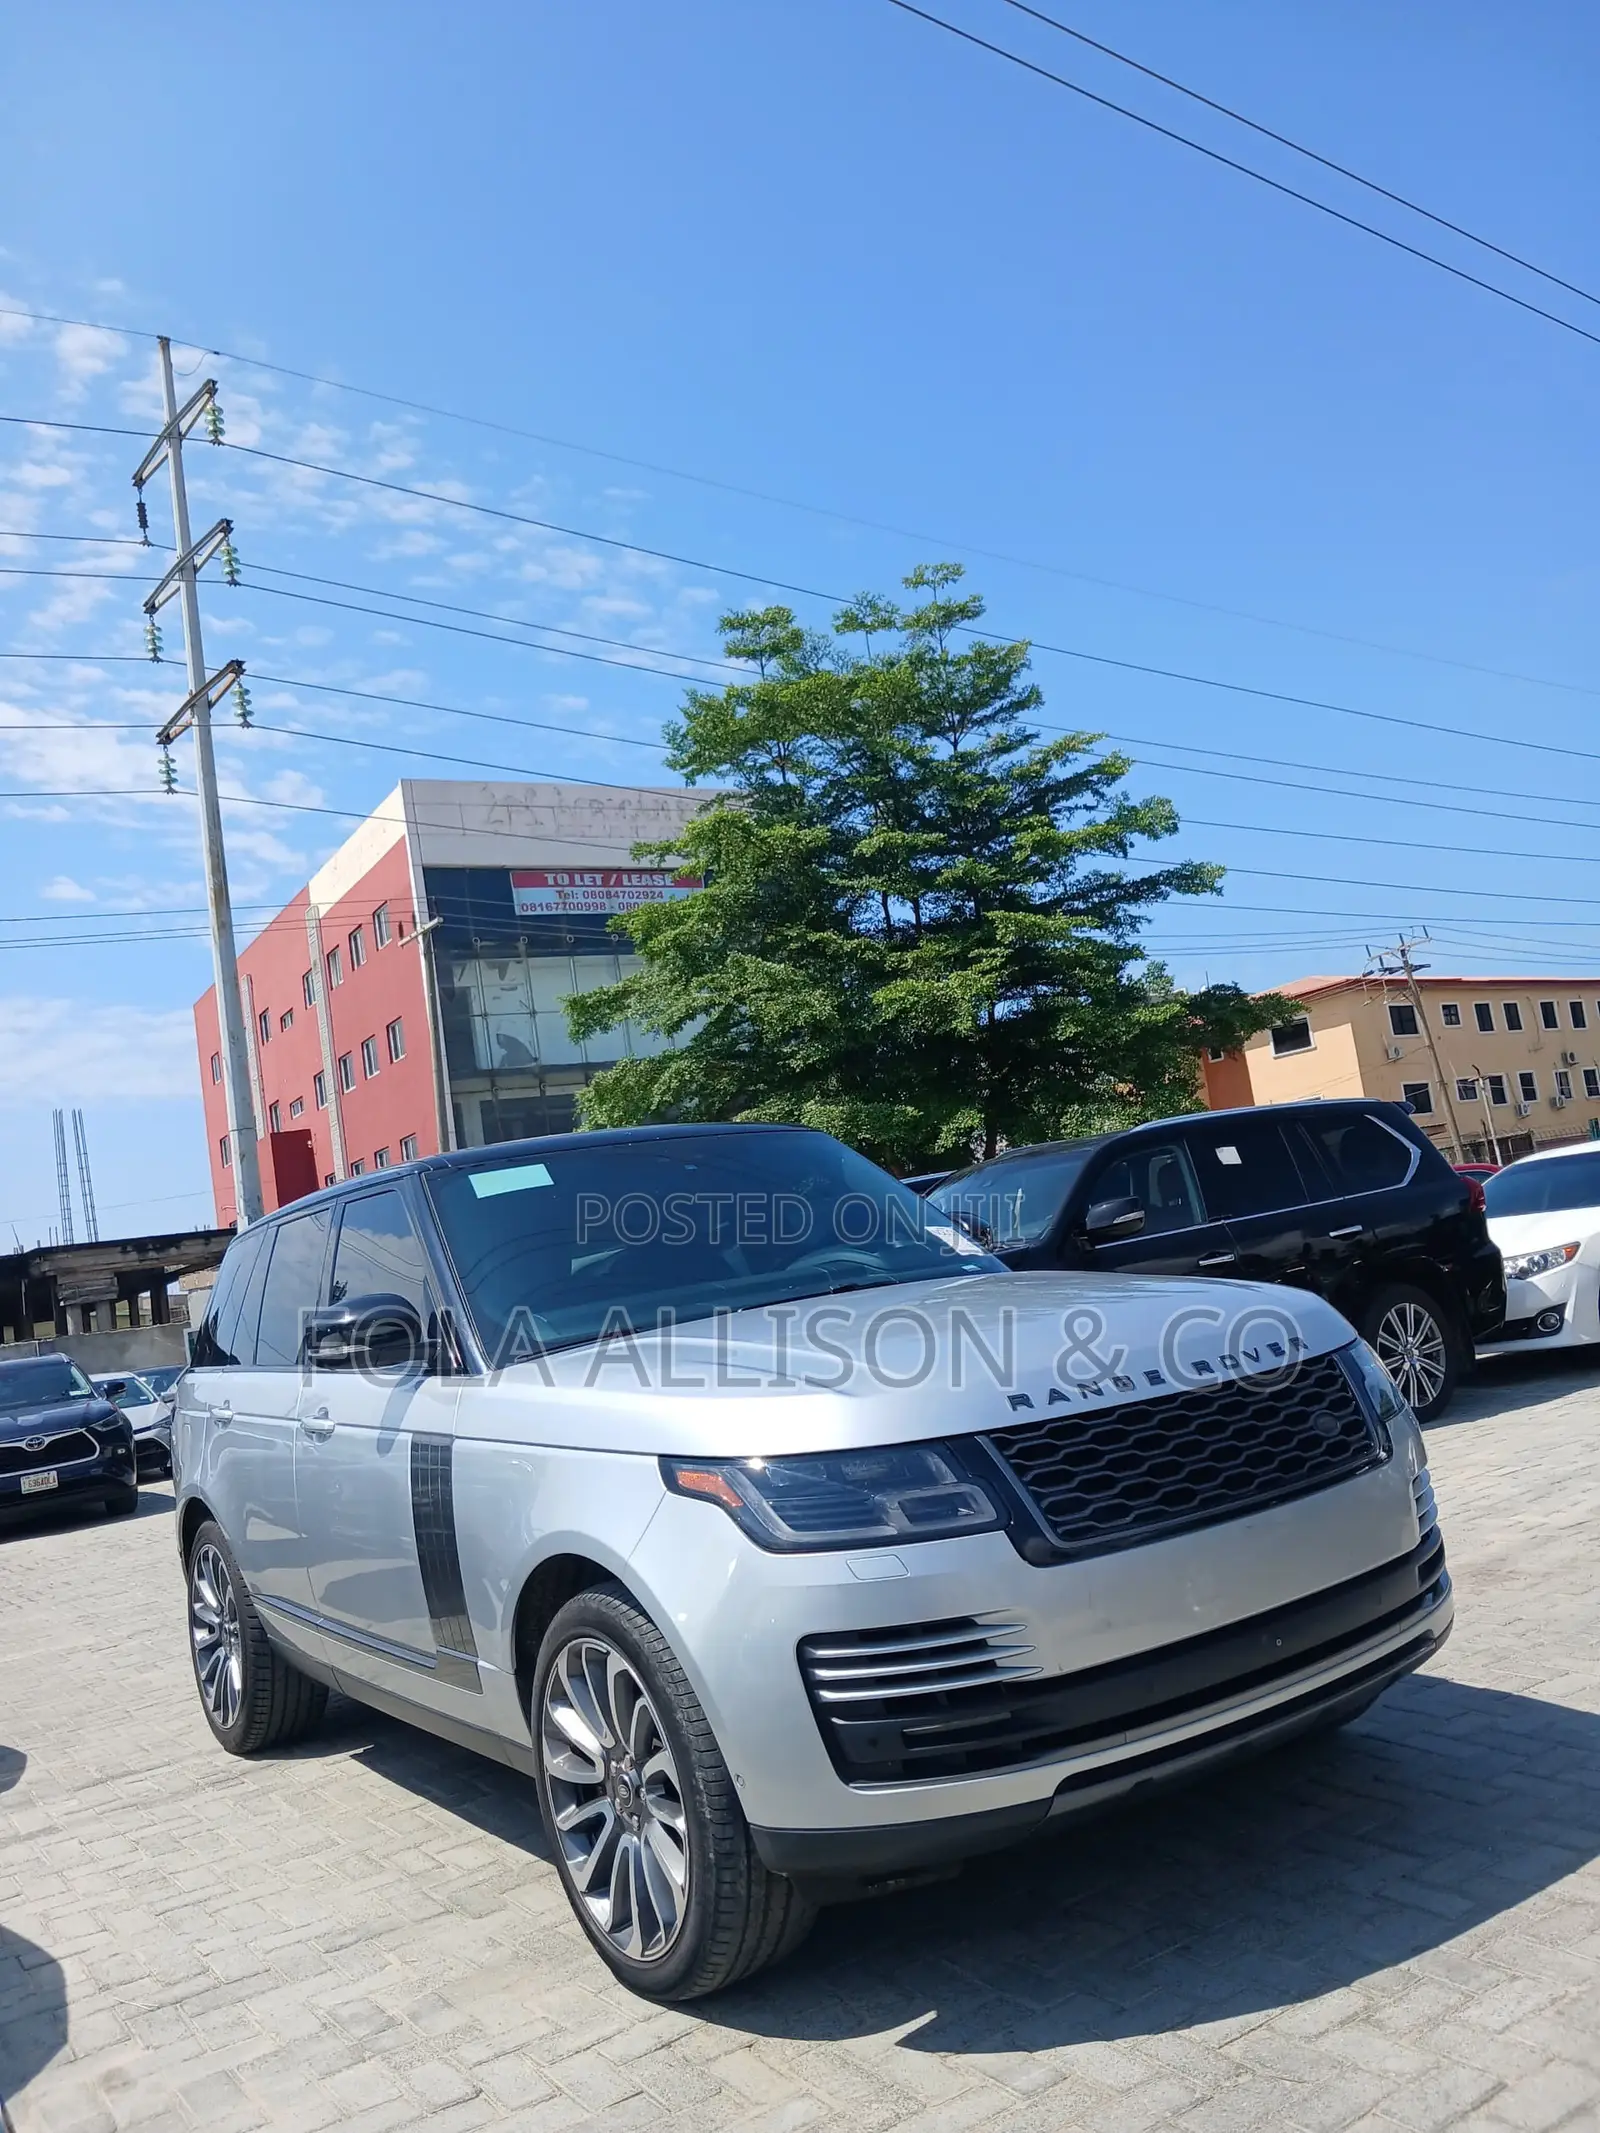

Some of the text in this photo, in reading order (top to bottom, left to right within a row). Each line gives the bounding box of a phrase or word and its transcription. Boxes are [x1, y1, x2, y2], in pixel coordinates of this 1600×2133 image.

[544, 873, 570, 886] TO
[574, 873, 604, 886] LET
[622, 874, 675, 886] LEASE
[556, 890, 579, 900] Tel:
[1005, 1335, 1311, 1412] RANGE ROVER
